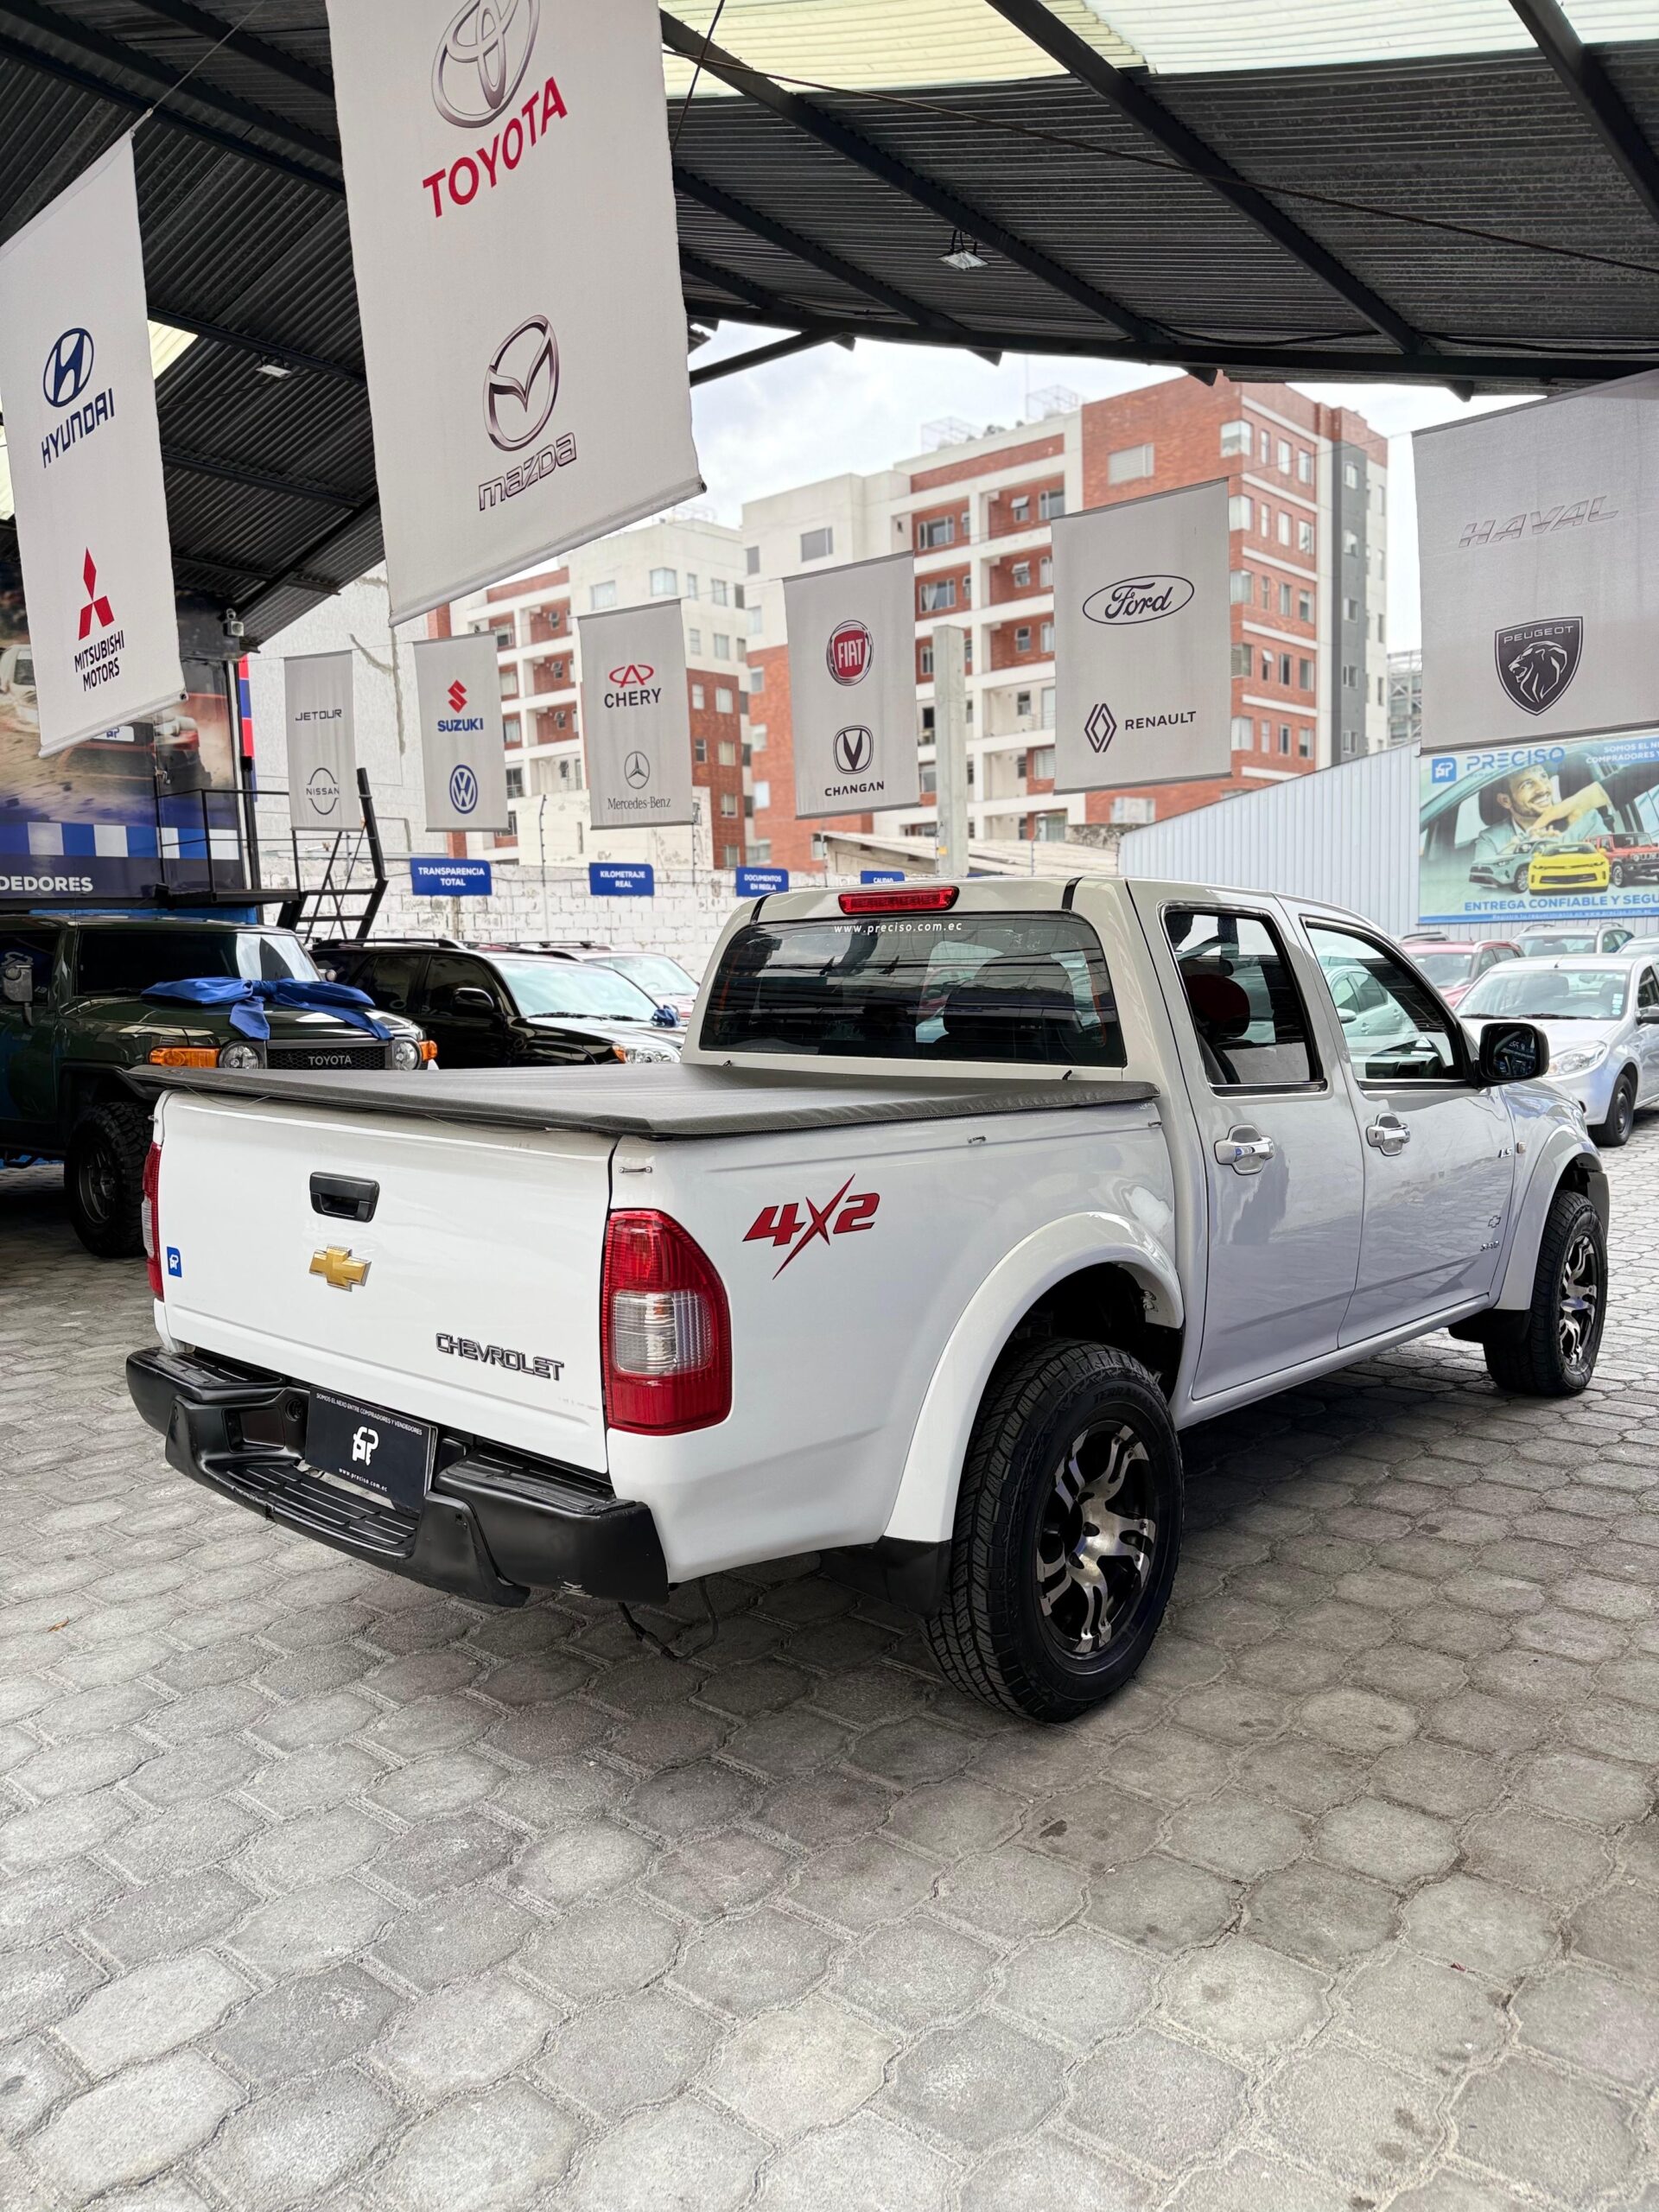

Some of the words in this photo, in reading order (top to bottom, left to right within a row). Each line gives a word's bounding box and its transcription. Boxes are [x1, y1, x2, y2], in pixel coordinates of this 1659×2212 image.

[423, 76, 568, 218] TOYOTA
[41, 388, 115, 468] HYUNDAI
[1459, 495, 1619, 549] HAVAL
[1104, 582, 1173, 619] Ford
[1503, 626, 1573, 644] PEUGEOT
[74, 630, 124, 673] MITSUBISHI
[837, 638, 863, 669] FIAT
[83, 657, 120, 691] MOTORS
[604, 688, 662, 709] CHERY
[295, 709, 342, 721] JETOUR
[1125, 711, 1197, 730] RENAULT
[437, 718, 484, 732] SUZUKI
[1604, 743, 1637, 753] SOMOS
[1466, 747, 1565, 771] PRECISO
[1586, 751, 1655, 764] COMPRADORES
[306, 787, 340, 796] NISSAN
[824, 781, 885, 797] CHANGAN
[607, 797, 671, 810] Mercedes-Benz
[418, 867, 485, 876] TRANSPARENCIA
[600, 870, 645, 879] KILOMETRAJE
[440, 878, 467, 887] TOTAL
[1464, 899, 1526, 912] ENTREGA
[1529, 895, 1608, 908] CONFIABLE
[1610, 895, 1619, 905] Y
[834, 921, 963, 935] www.preciso.com.ec
[308, 1055, 353, 1066] TOYOTA
[435, 1332, 564, 1381] CHEVROLET
[316, 1392, 331, 1403] SOMOS
[347, 1402, 359, 1413] ENTRE
[359, 1408, 391, 1424] COMPRADORES
[395, 1420, 423, 1436] VENDEDORES
[338, 1467, 388, 1492] www.preciso.com.ec
